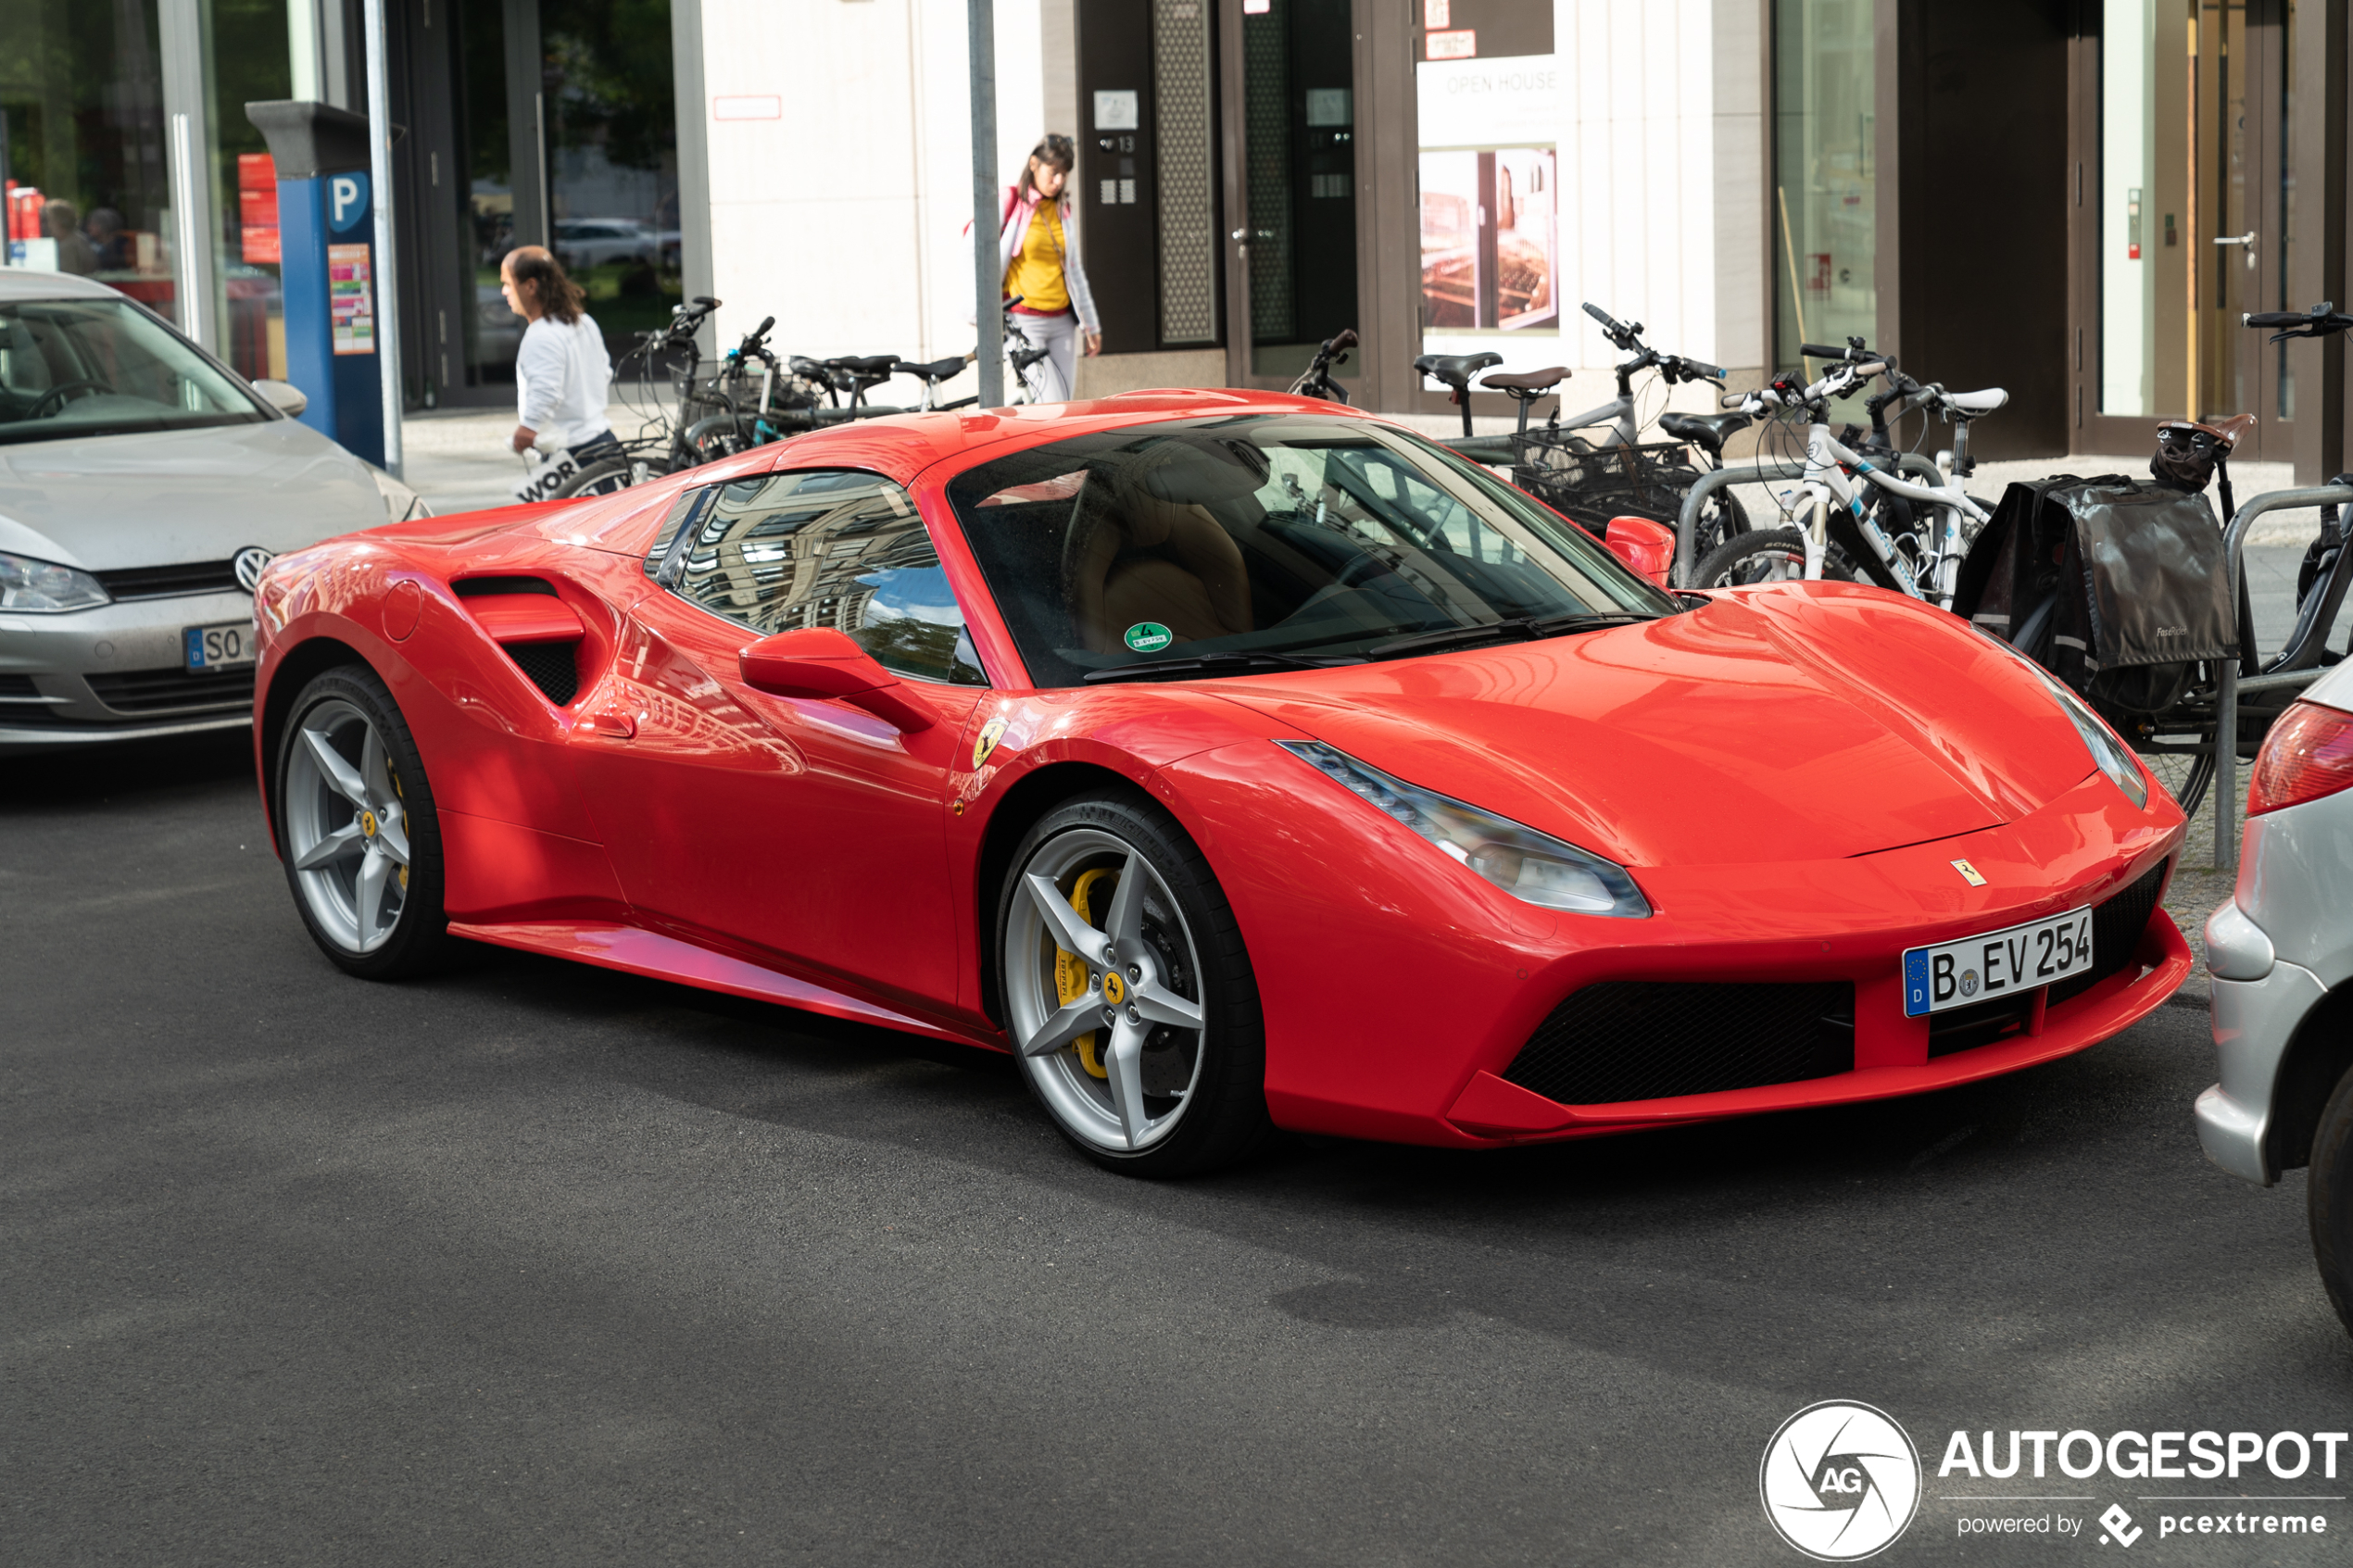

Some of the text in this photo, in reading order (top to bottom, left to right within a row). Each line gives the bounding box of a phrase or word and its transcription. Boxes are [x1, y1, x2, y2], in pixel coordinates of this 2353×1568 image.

[1447, 71, 1556, 94] OPEN HOUSE
[1119, 136, 1135, 153] 13
[333, 178, 358, 221] P
[1765, 542, 1804, 553] SCHW
[1140, 624, 1153, 637] 4
[2157, 626, 2187, 637] FastRider
[206, 630, 241, 660] SO
[1113, 812, 1165, 858] MICHELIN
[1932, 953, 1957, 1002] B
[1983, 934, 2027, 991] EV
[2037, 916, 2089, 977] 254
[1914, 989, 1922, 1003] D
